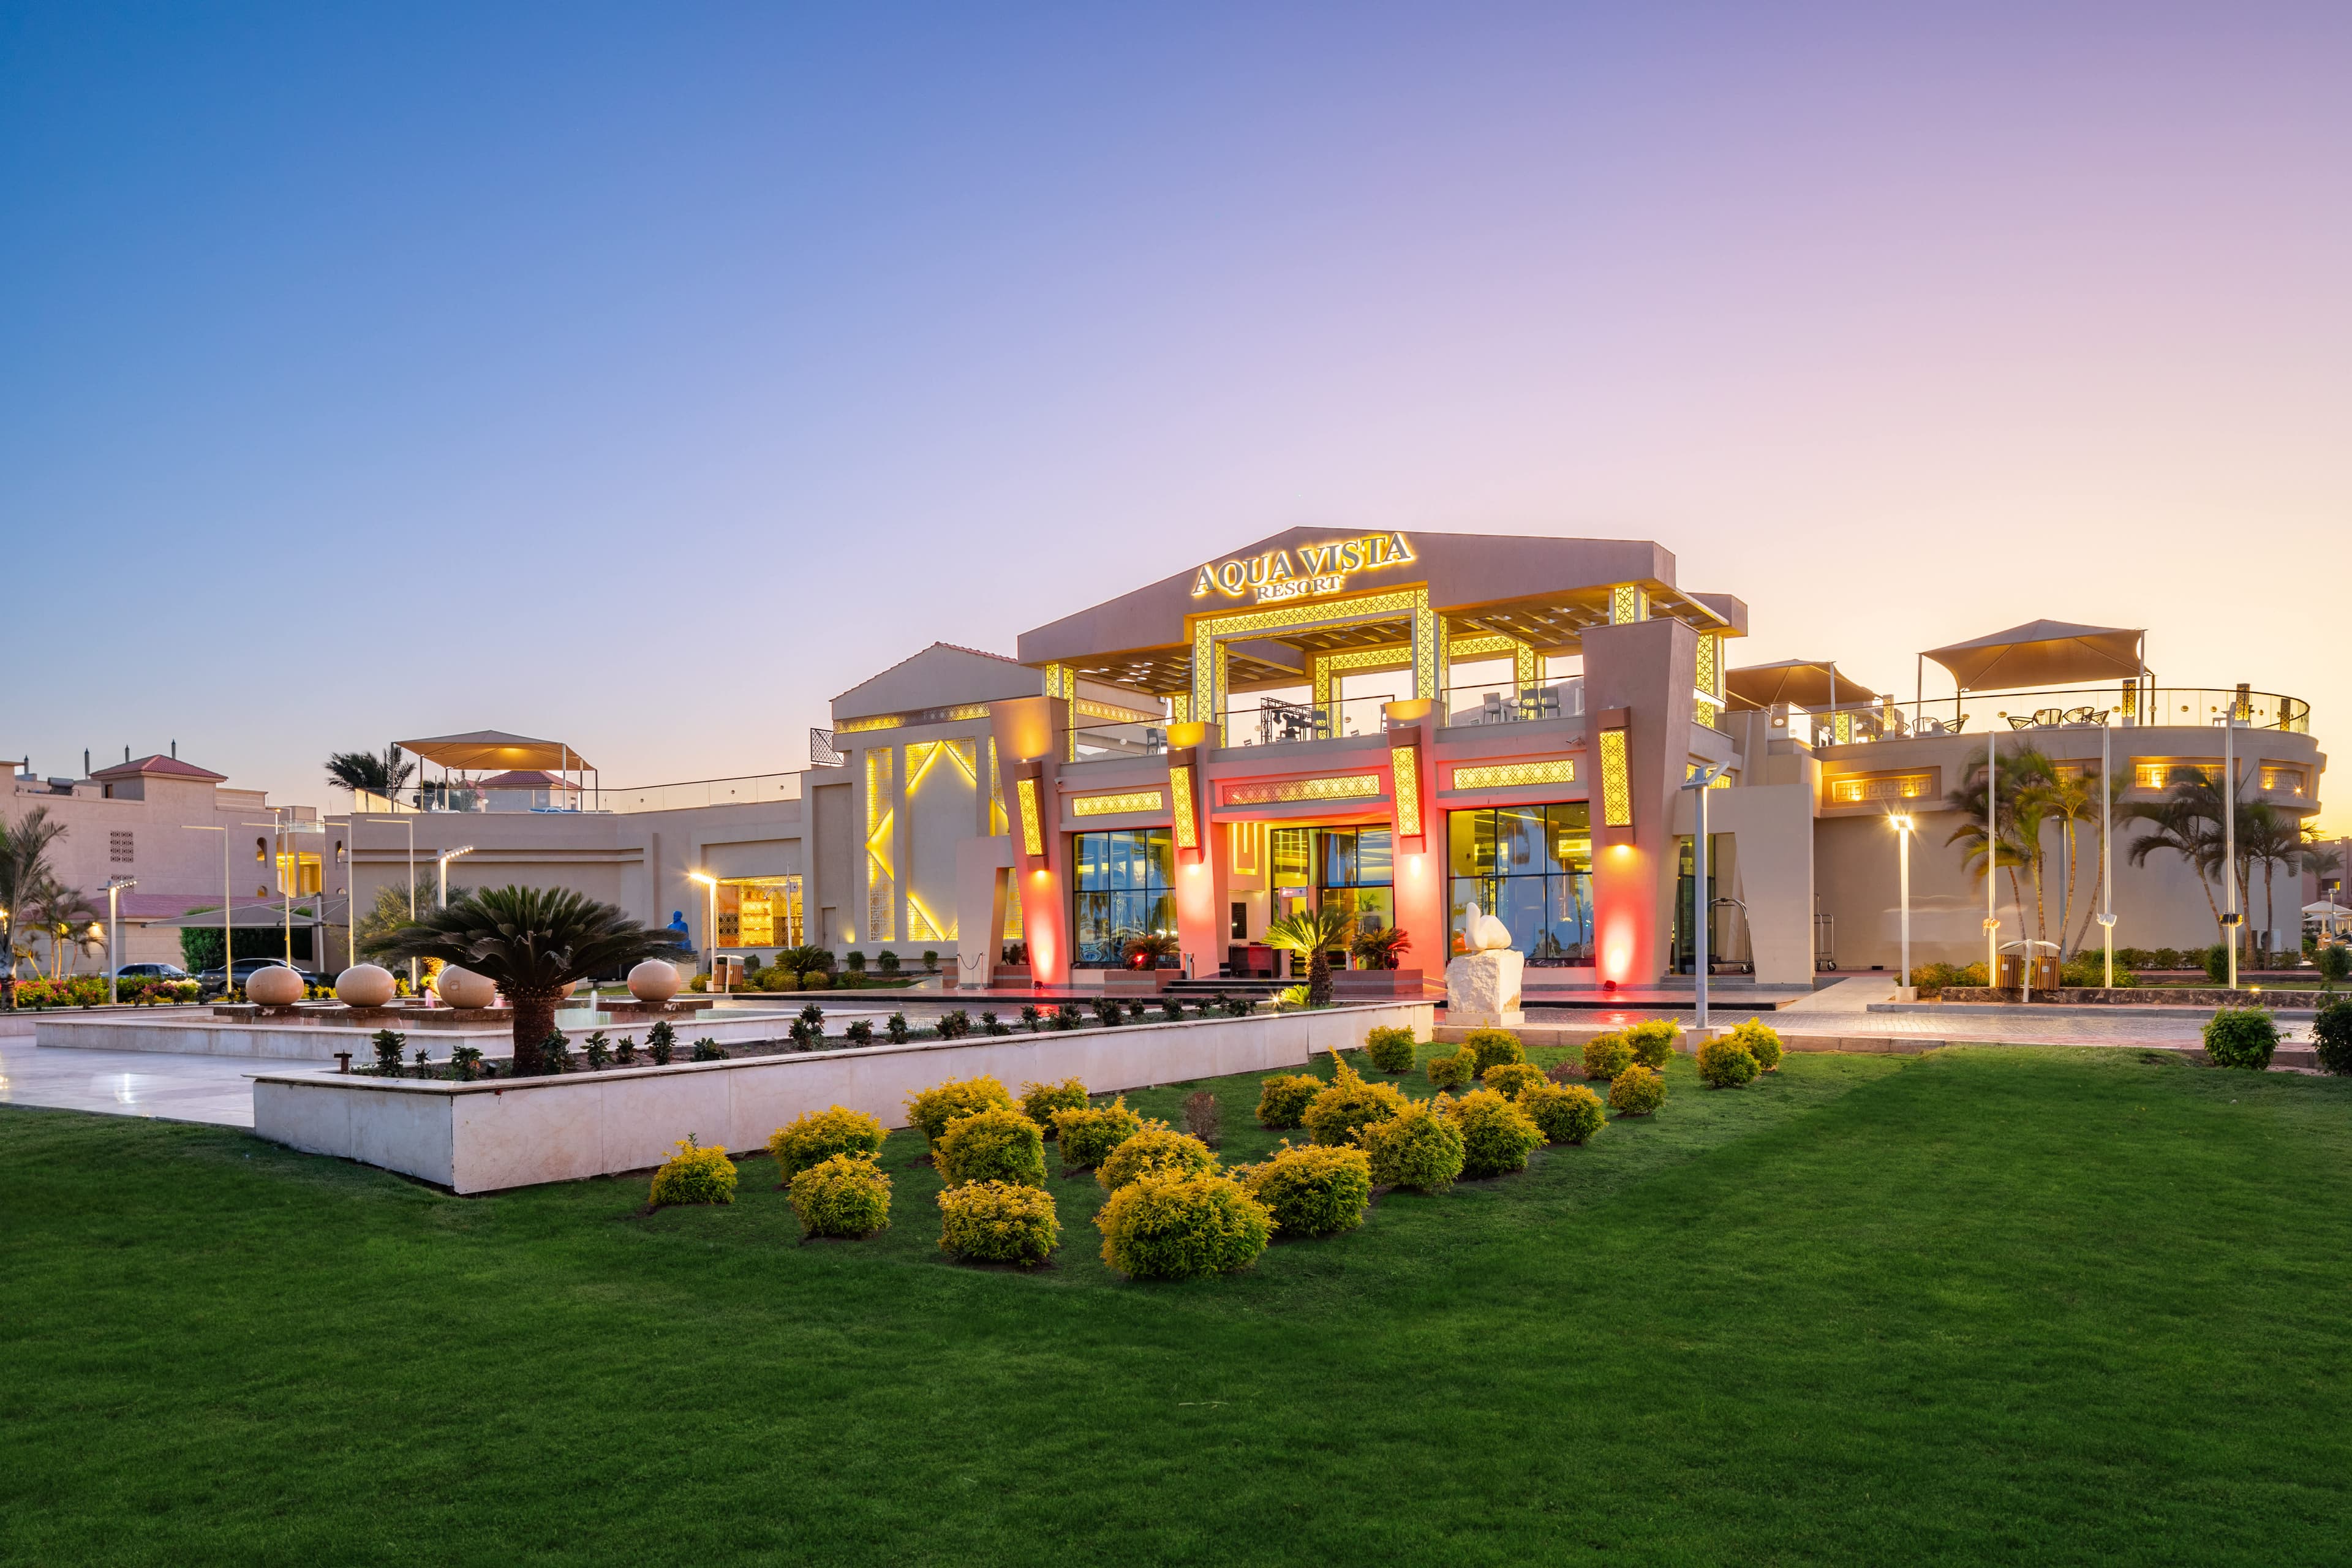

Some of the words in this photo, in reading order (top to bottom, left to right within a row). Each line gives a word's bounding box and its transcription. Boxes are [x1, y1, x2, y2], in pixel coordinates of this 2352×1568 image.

[1192, 552, 1295, 594] AQUA
[1299, 533, 1411, 575] VISTA
[1256, 576, 1340, 600] RESORT
